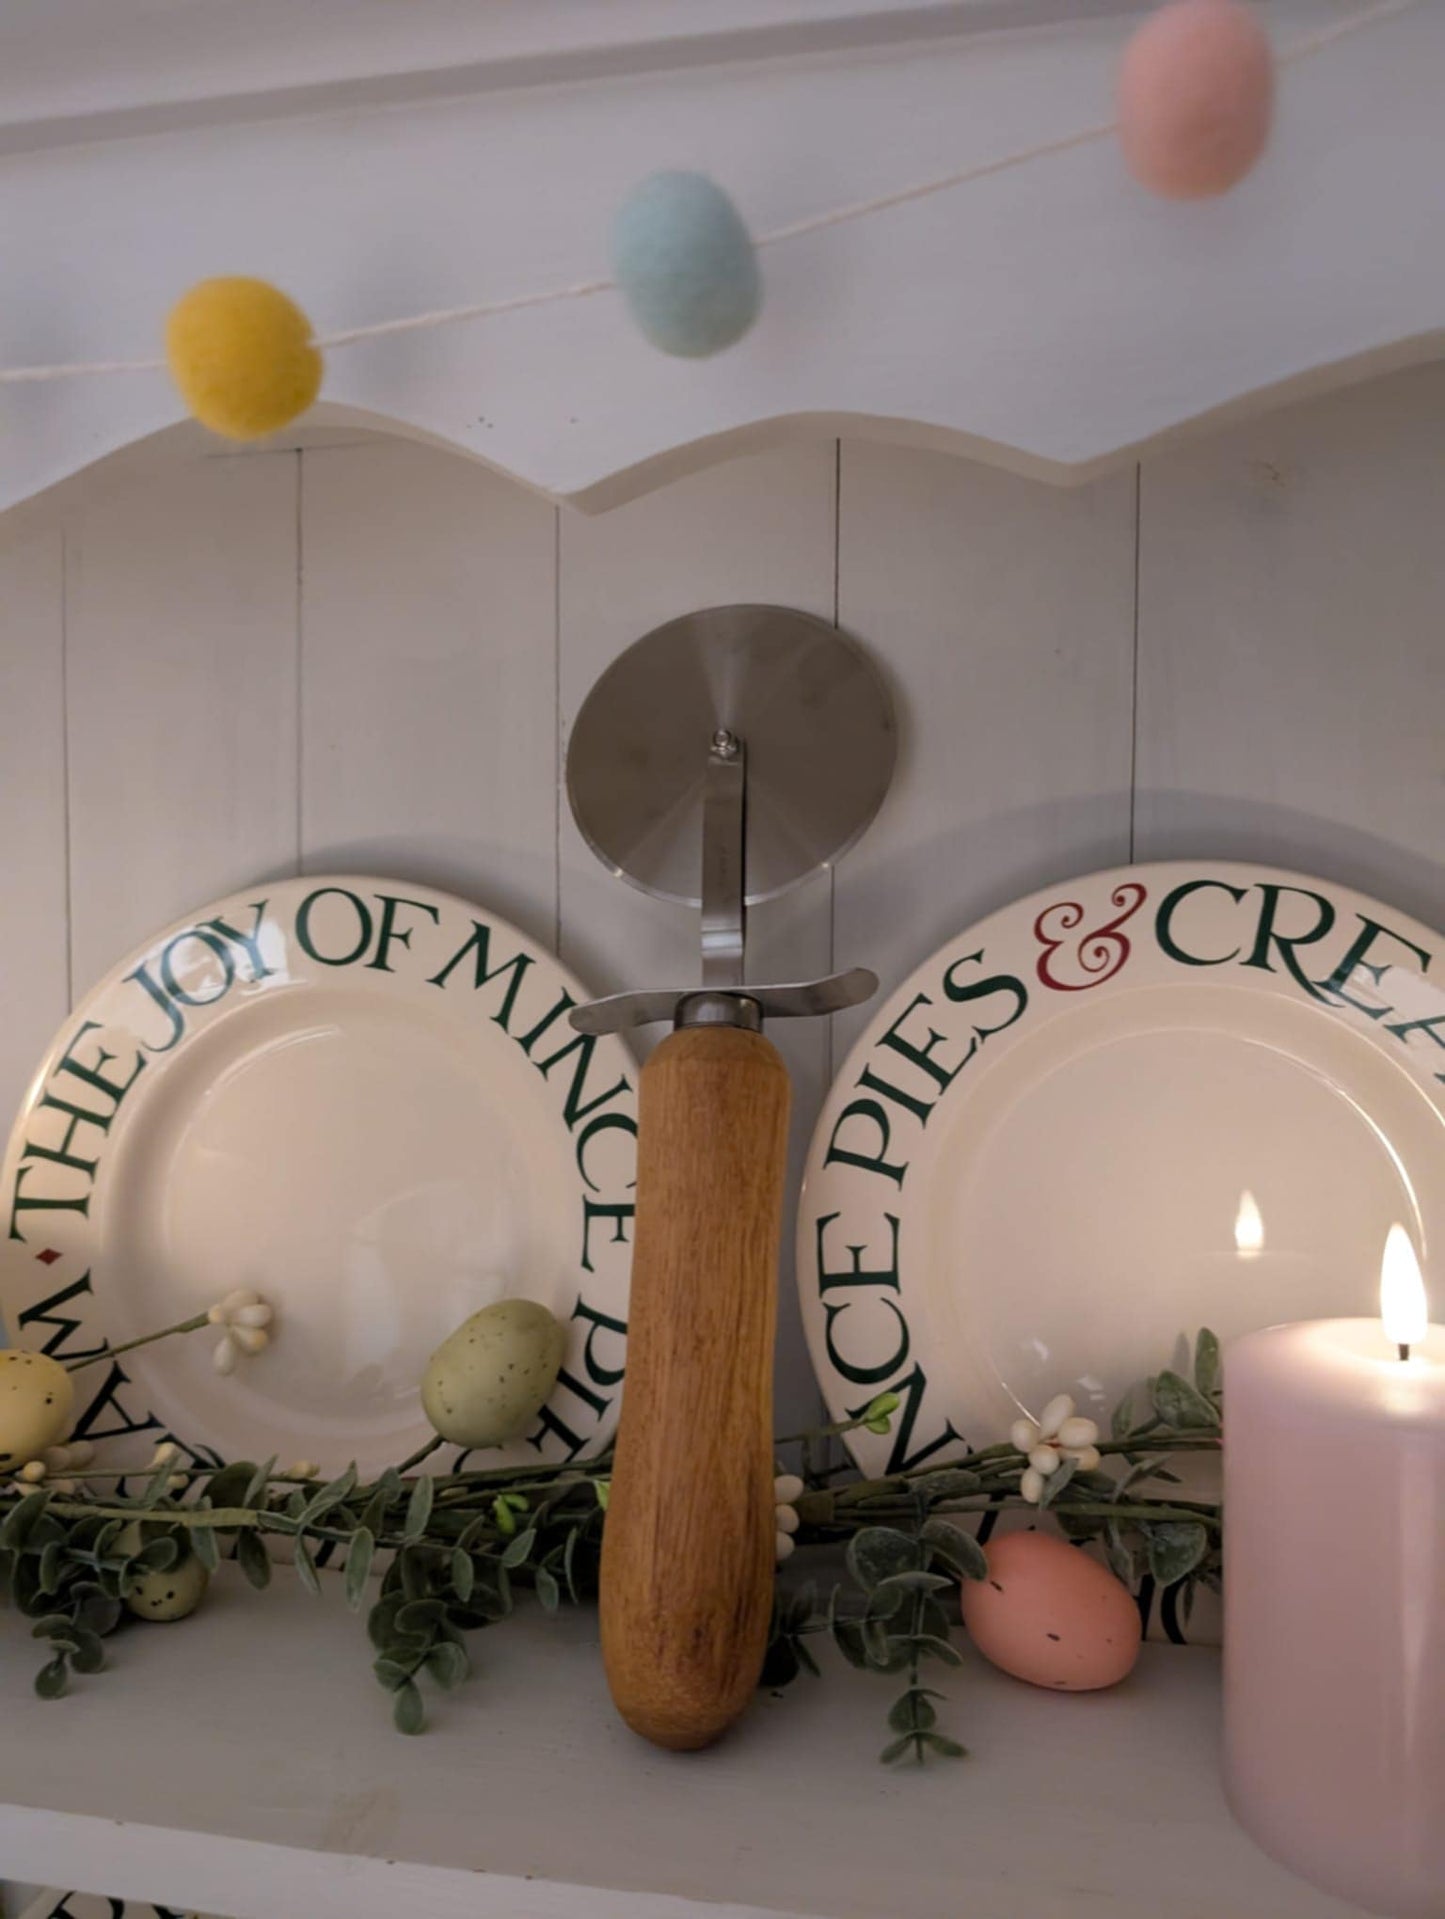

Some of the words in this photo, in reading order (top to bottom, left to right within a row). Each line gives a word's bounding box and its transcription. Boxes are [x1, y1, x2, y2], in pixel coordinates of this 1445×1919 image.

[1034, 882, 1148, 992] &
[8, 1020, 147, 1244] THE
[122, 899, 276, 1053] JOY
[295, 887, 440, 972] OF
[425, 919, 639, 1274] MINCE
[823, 948, 1028, 1192] PIES
[816, 1211, 974, 1476] NCE
